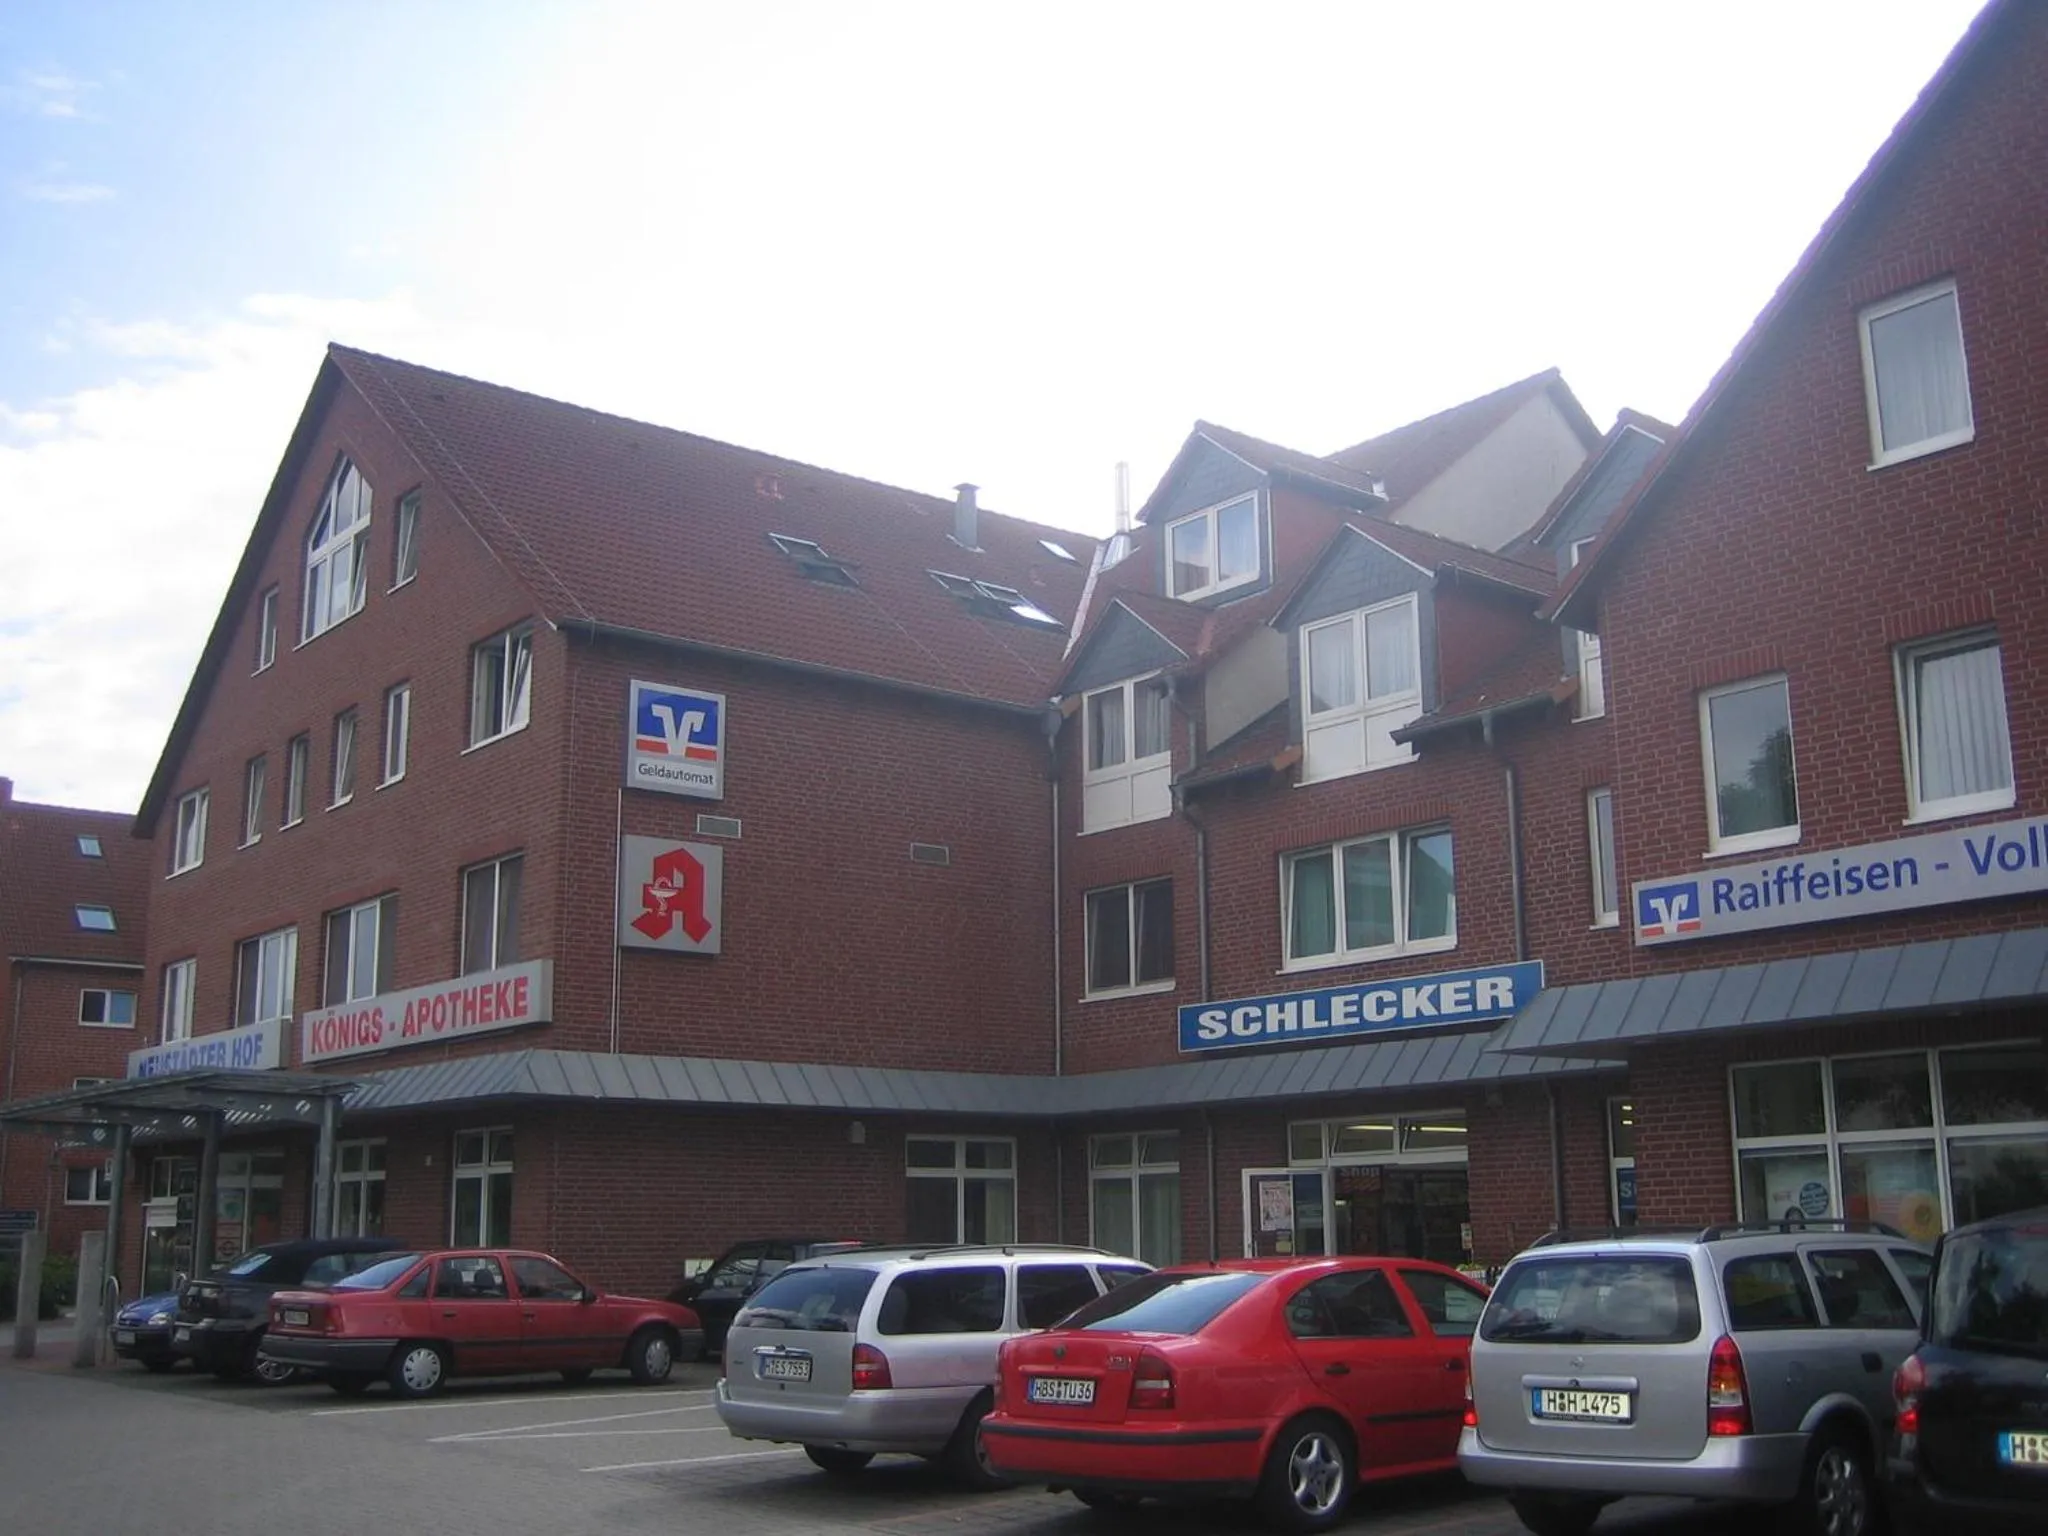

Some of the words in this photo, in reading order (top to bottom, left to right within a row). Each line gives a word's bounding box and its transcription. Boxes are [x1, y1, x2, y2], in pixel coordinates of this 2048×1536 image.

[638, 763, 714, 785] Geldautomat
[1712, 856, 1918, 915] Raiffeisen
[310, 1007, 384, 1054] KÖNIGS
[402, 976, 528, 1038] APOTHEKE
[1197, 976, 1515, 1040] SCHLECKER
[231, 1033, 264, 1067] HOF
